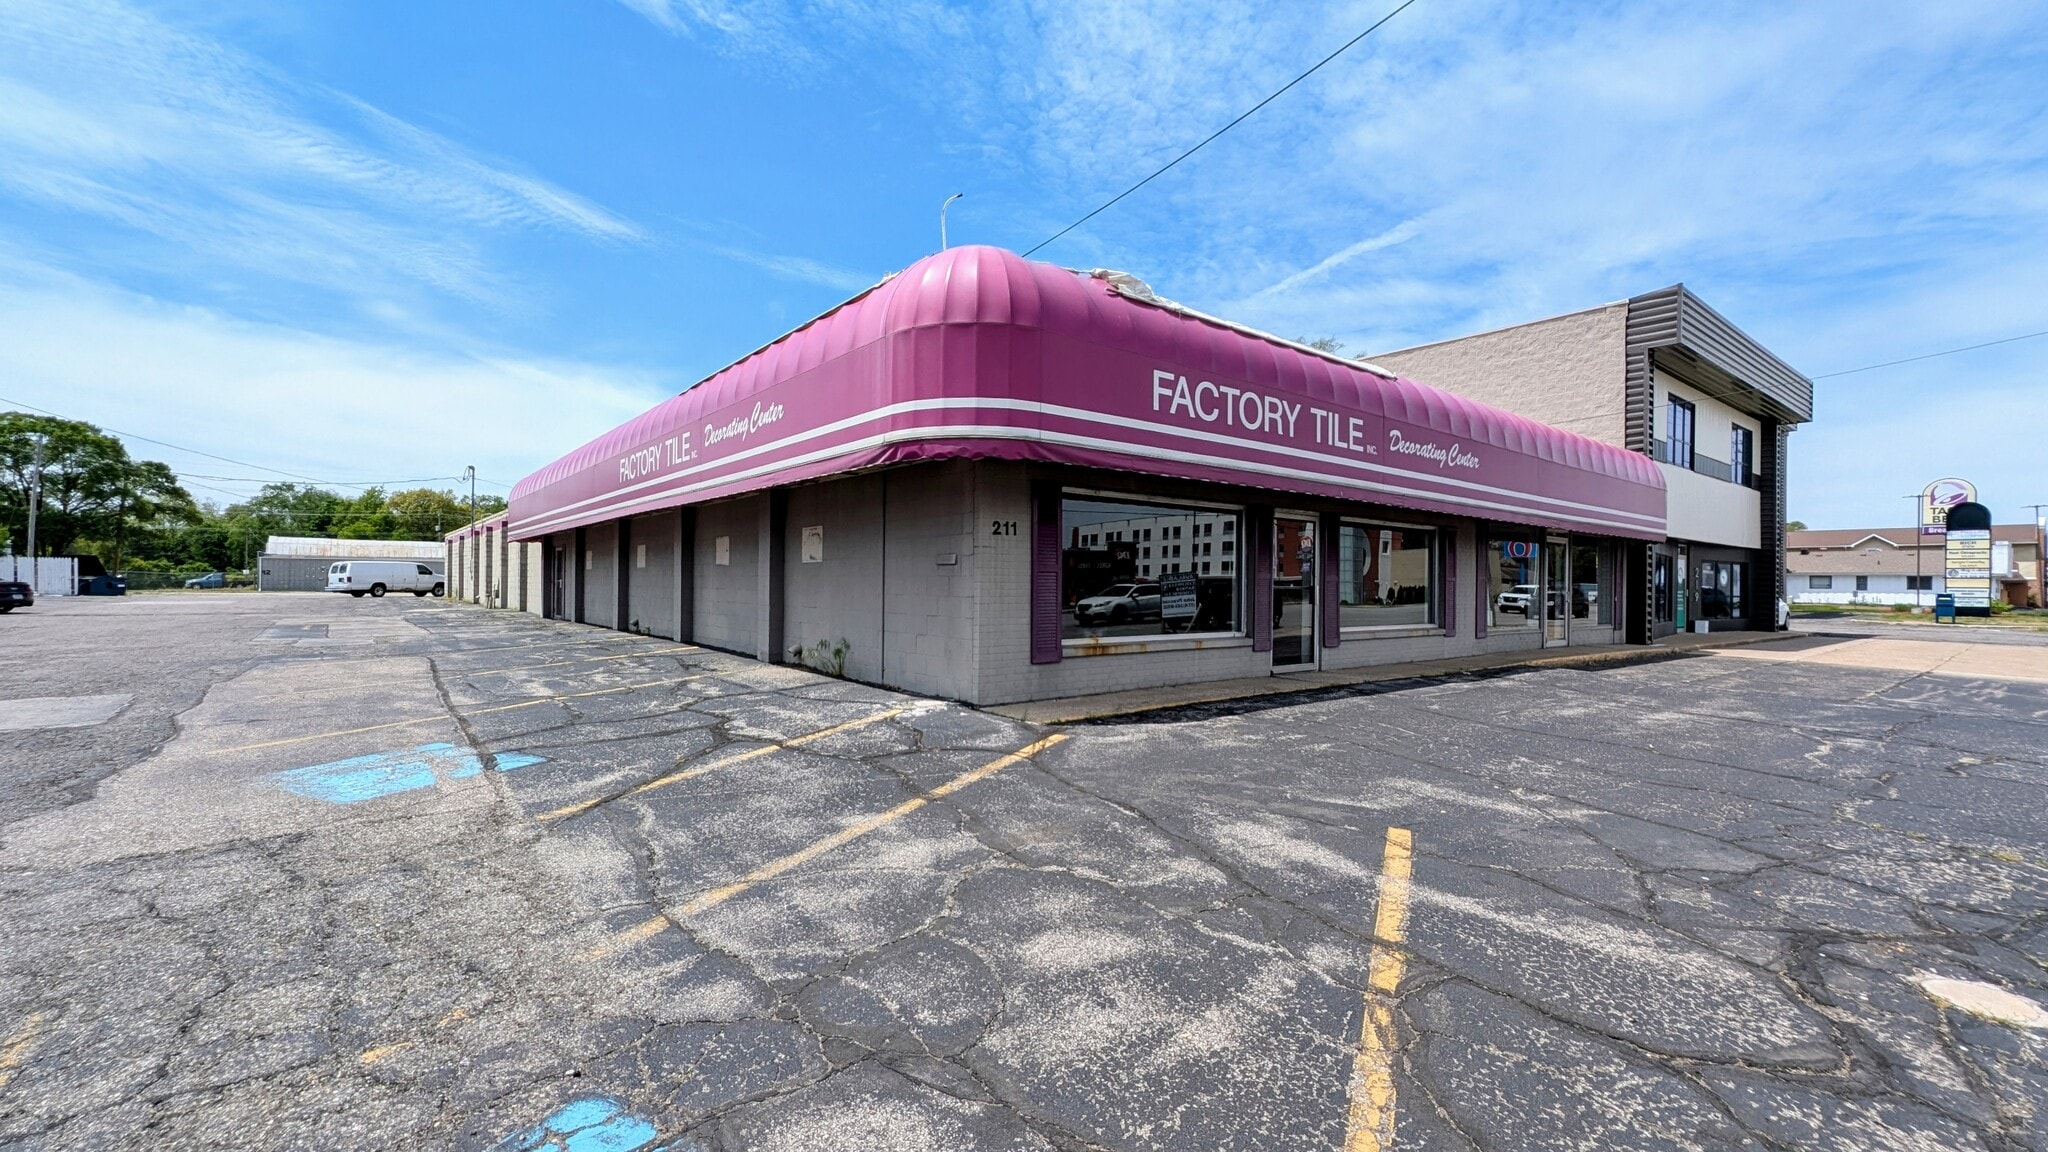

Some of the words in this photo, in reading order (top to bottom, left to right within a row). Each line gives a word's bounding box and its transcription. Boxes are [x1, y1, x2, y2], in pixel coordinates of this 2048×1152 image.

[704, 417, 749, 447] Decorating
[750, 401, 785, 433] Center
[1152, 369, 1301, 437] FACTORY
[1310, 407, 1364, 452] TILE
[619, 443, 662, 483] FACTORY
[665, 432, 690, 468] TILE
[1389, 429, 1446, 468] Decorating
[1448, 442, 1480, 469] Center
[992, 520, 1017, 536] 211
[1929, 507, 1949, 515] TA
[1932, 515, 1947, 523] BE
